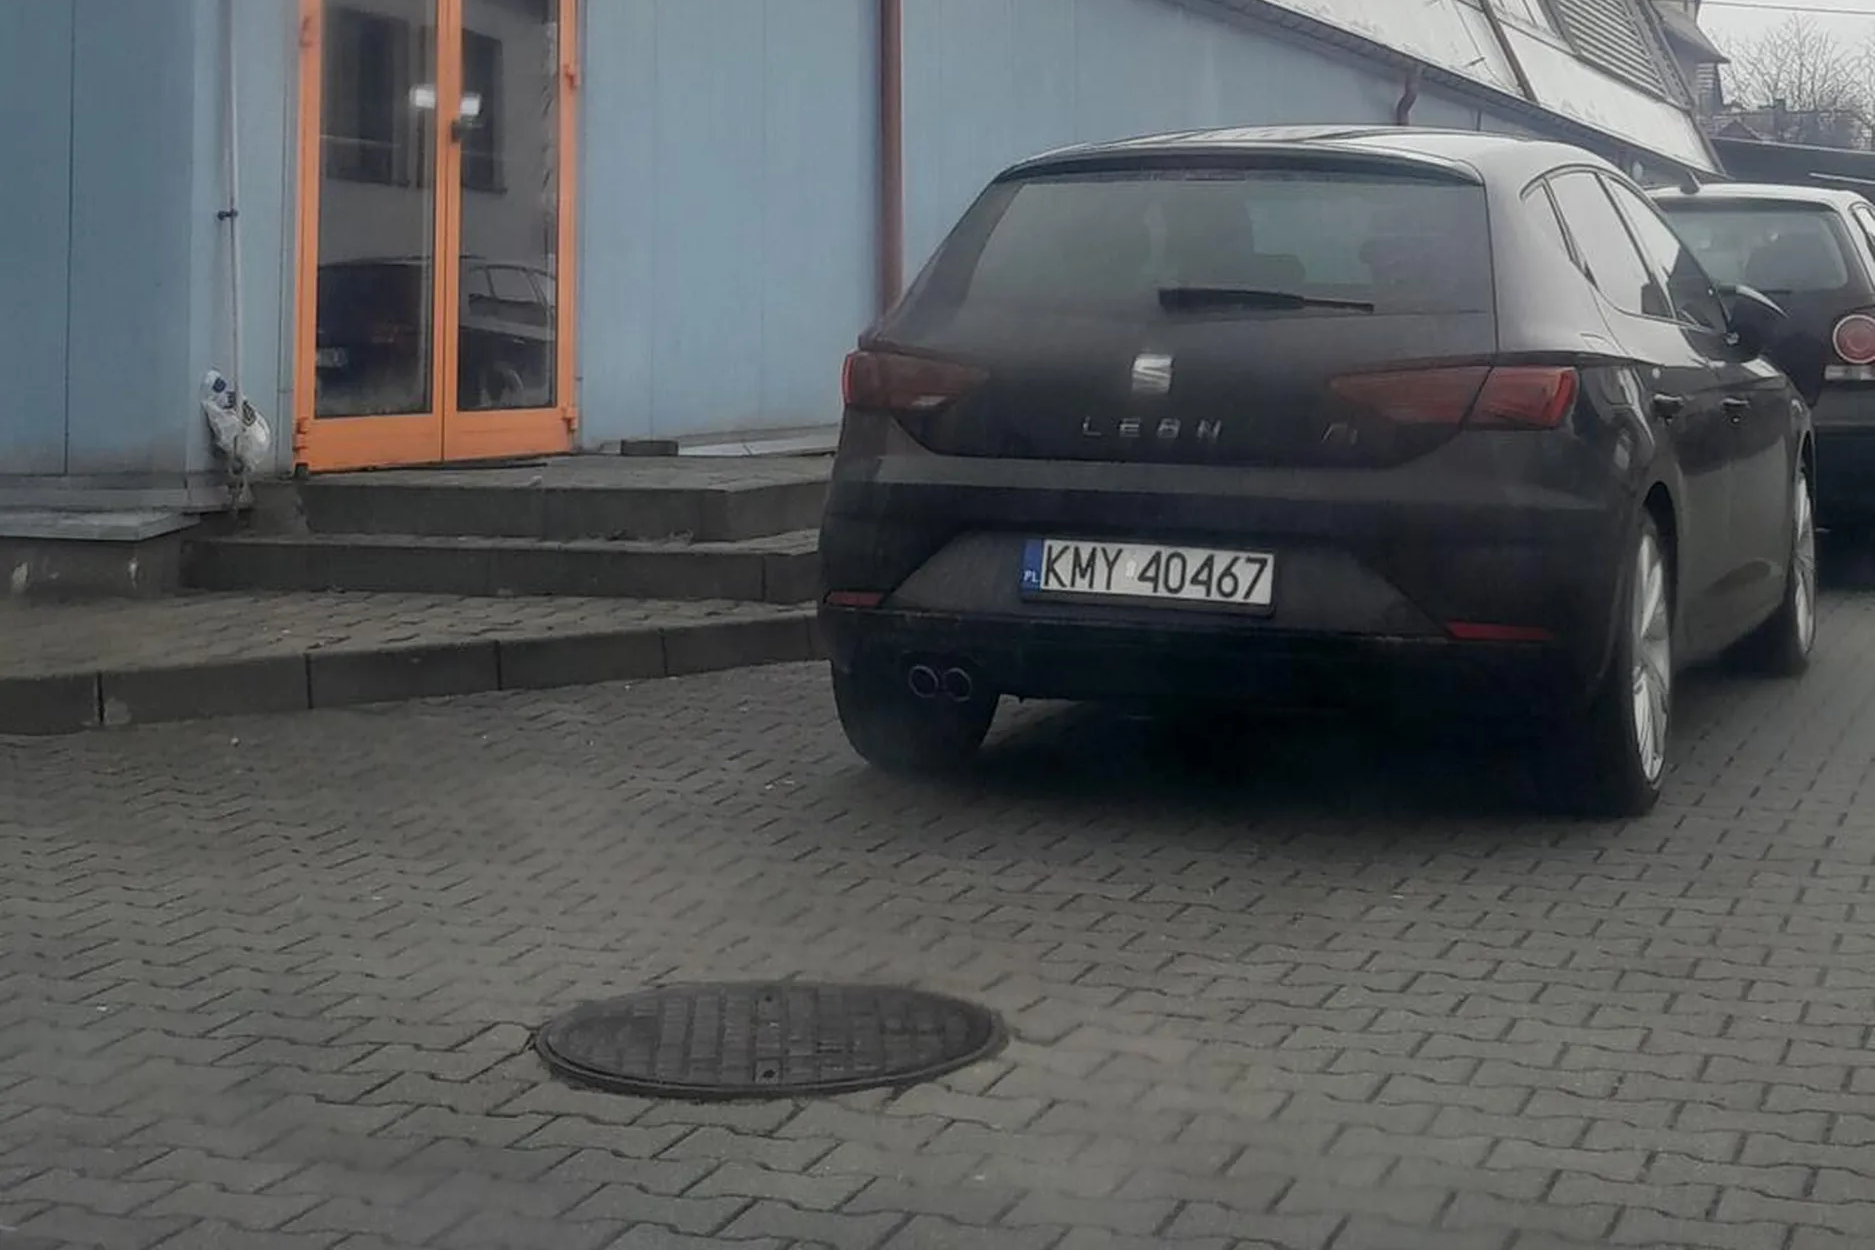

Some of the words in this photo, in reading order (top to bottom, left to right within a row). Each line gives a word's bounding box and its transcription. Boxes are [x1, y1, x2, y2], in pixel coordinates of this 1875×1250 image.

[1024, 571, 1039, 583] PL
[1043, 545, 1123, 590] KMY
[1137, 550, 1268, 600] 40467
